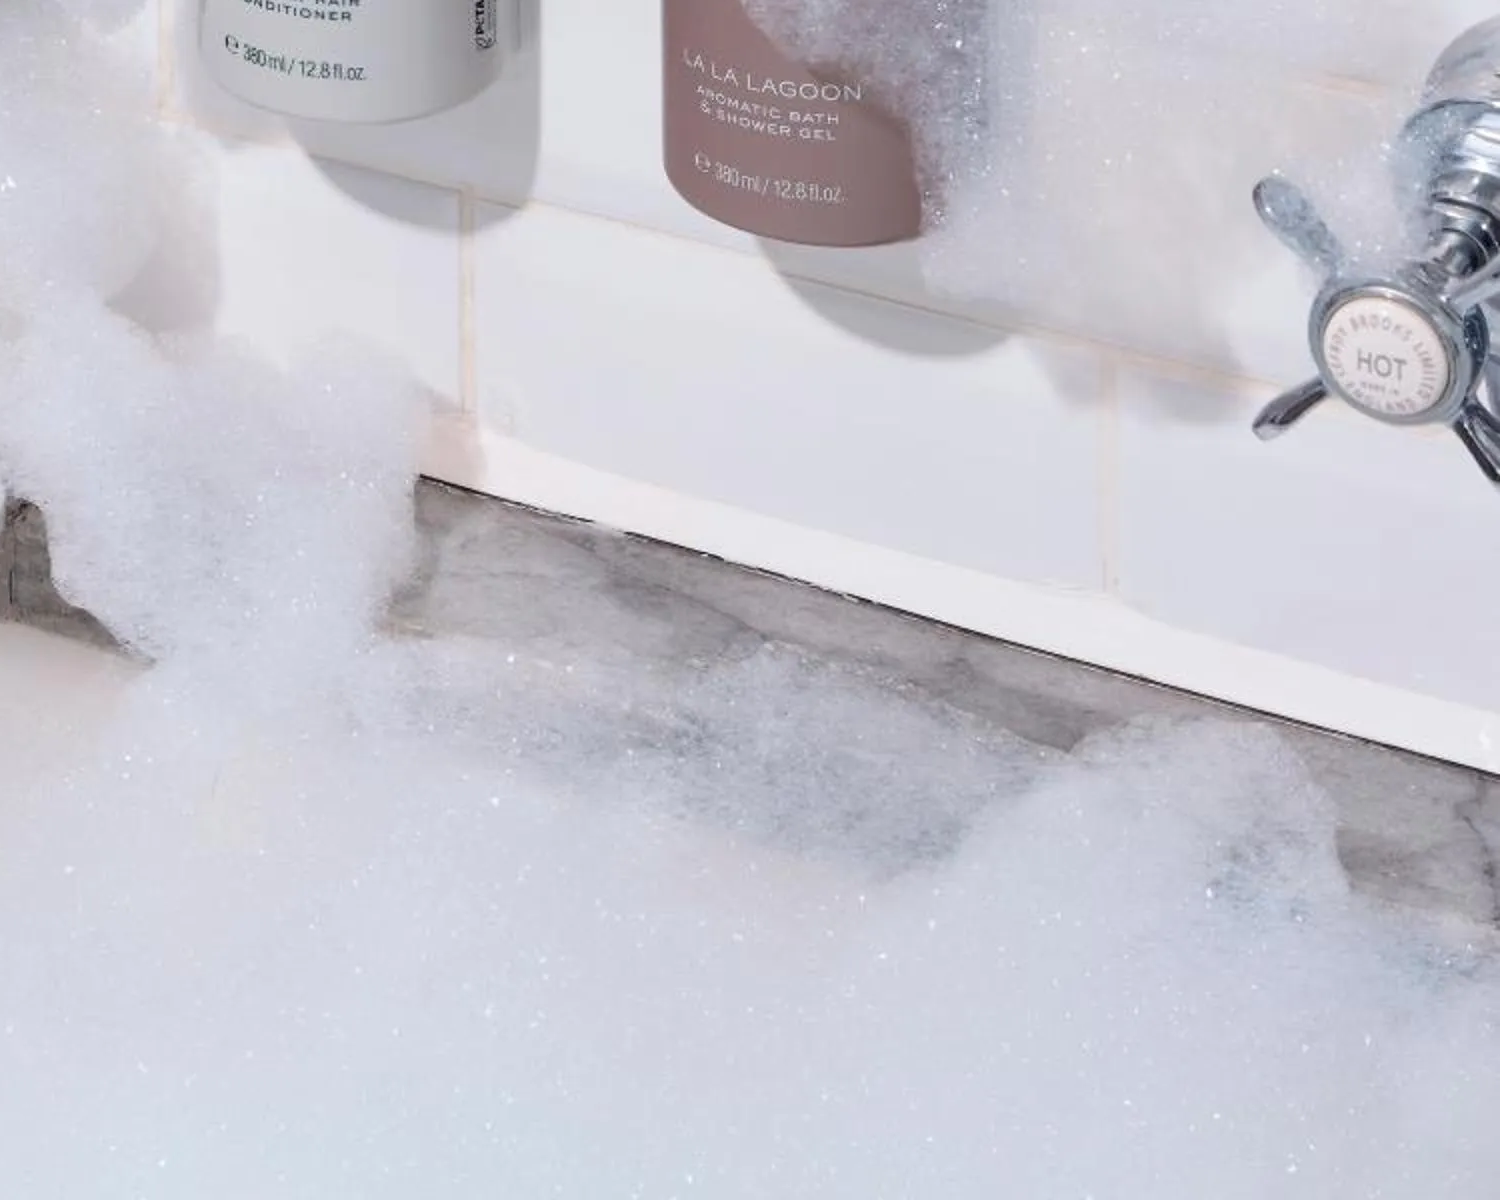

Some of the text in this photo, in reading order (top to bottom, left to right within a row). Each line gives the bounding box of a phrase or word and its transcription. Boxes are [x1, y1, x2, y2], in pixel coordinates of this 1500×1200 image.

[683, 49, 861, 101] LA LA LAGOON
[697, 85, 839, 125] AROMATIC BATH
[700, 100, 836, 141] & SHOWER GEL
[1357, 348, 1407, 380] HOT
